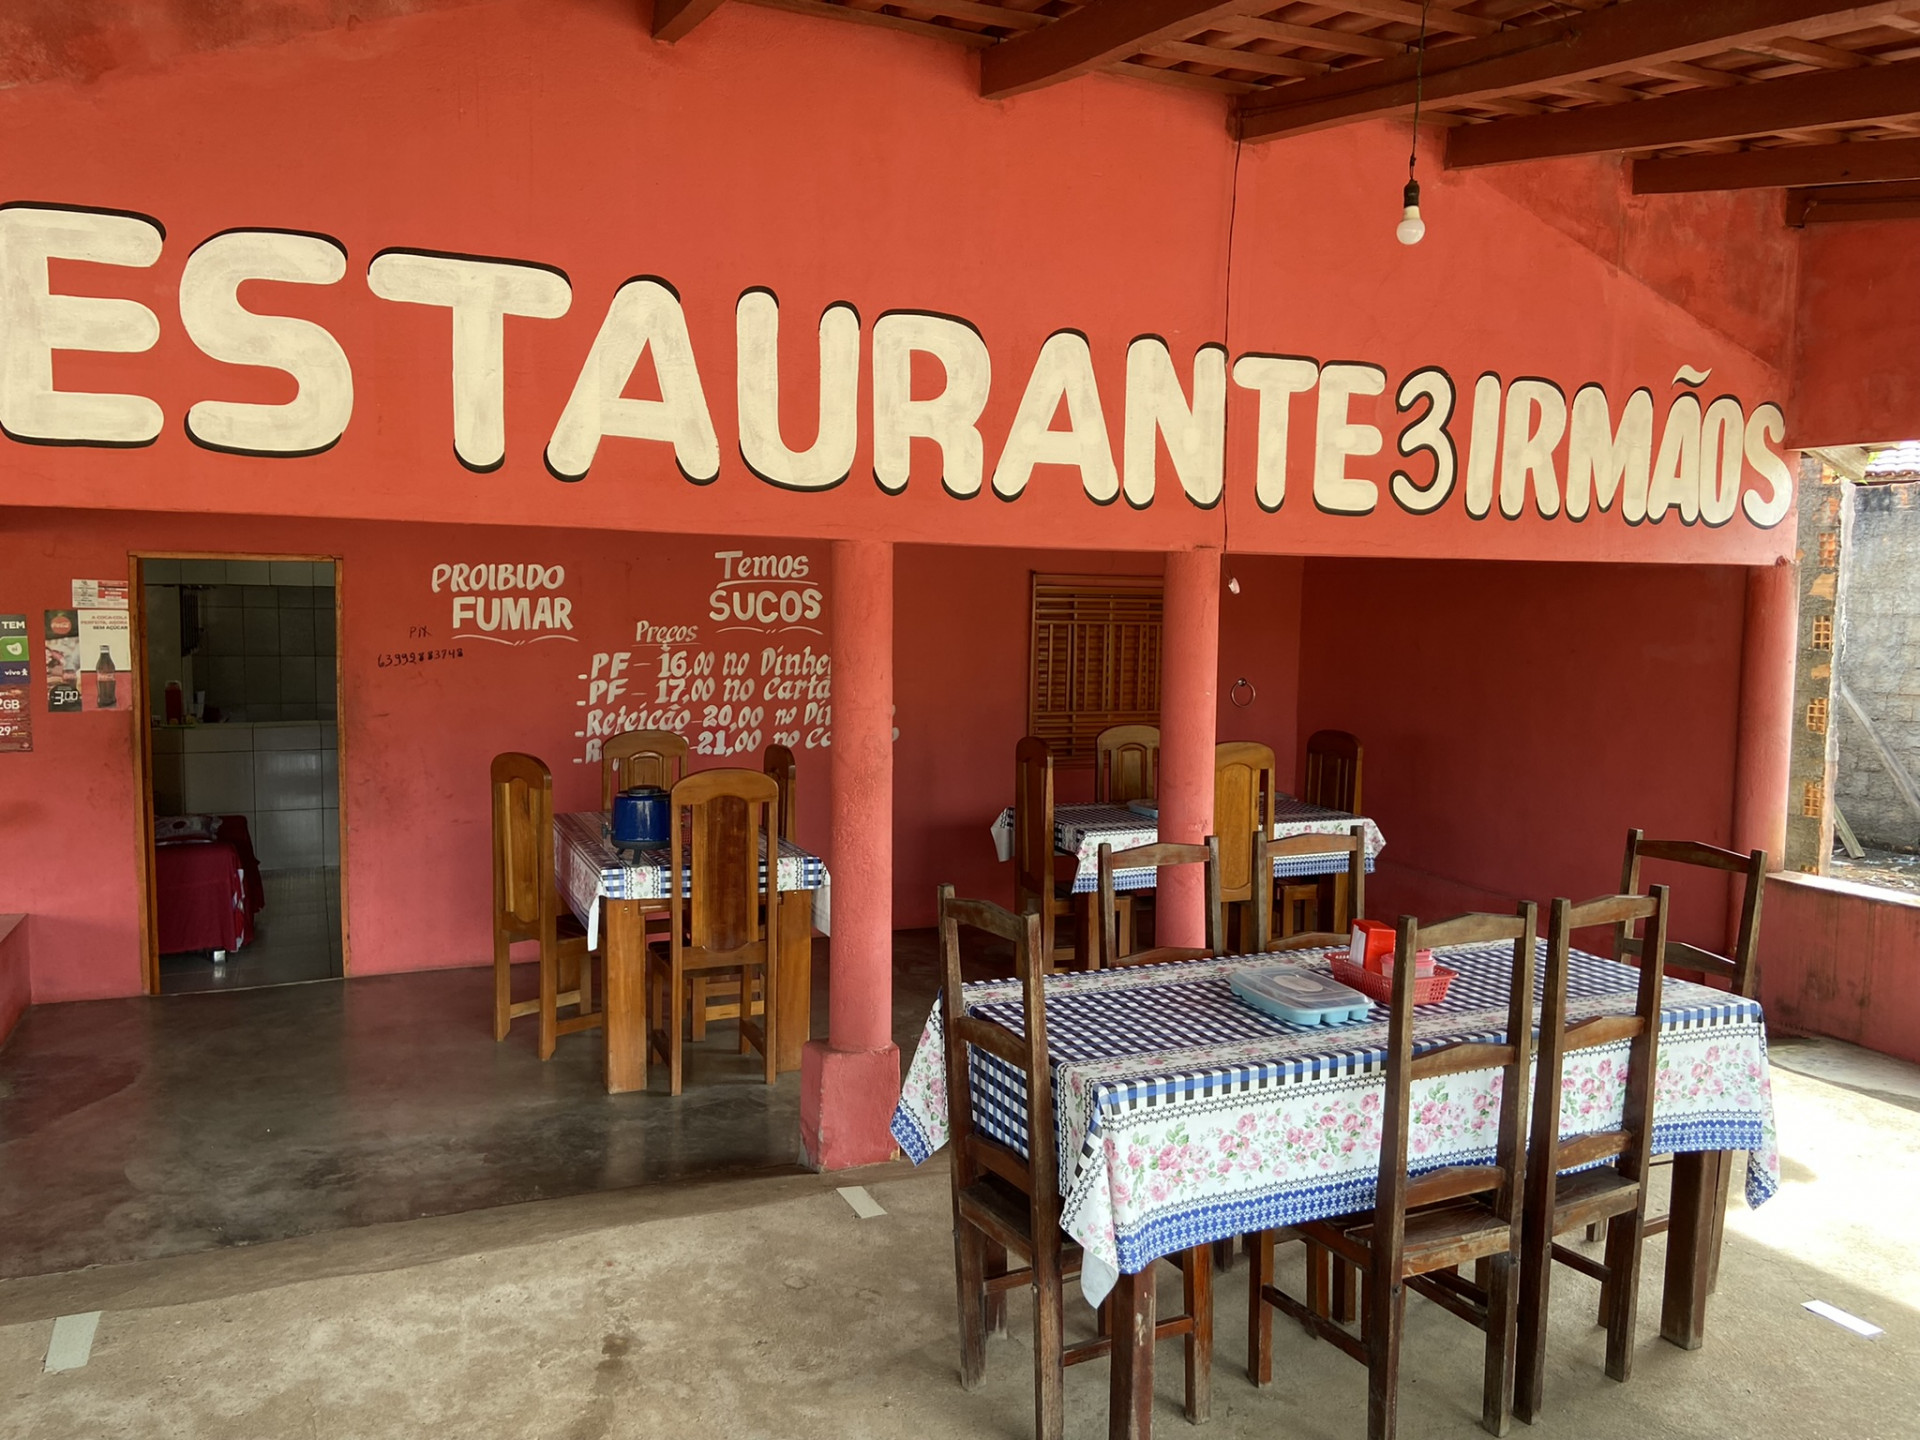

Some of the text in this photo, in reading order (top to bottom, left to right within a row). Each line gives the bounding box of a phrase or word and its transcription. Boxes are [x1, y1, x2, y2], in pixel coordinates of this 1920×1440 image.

[0, 201, 1795, 530] ESTAURANTE 3 IRMÃOS
[431, 563, 565, 593] PROIBIDO
[715, 550, 810, 579] Temos
[452, 596, 574, 631] FUMAR
[709, 588, 823, 623] SUCOS
[1, 621, 25, 629] TEM
[656, 650, 715, 679] 16,00
[722, 652, 750, 676] no
[654, 677, 716, 704] 17,00
[723, 678, 755, 702] no
[763, 674, 831, 701] Cartã
[702, 704, 765, 735] 20,00
[775, 705, 798, 726] no
[696, 728, 763, 757] 21,00
